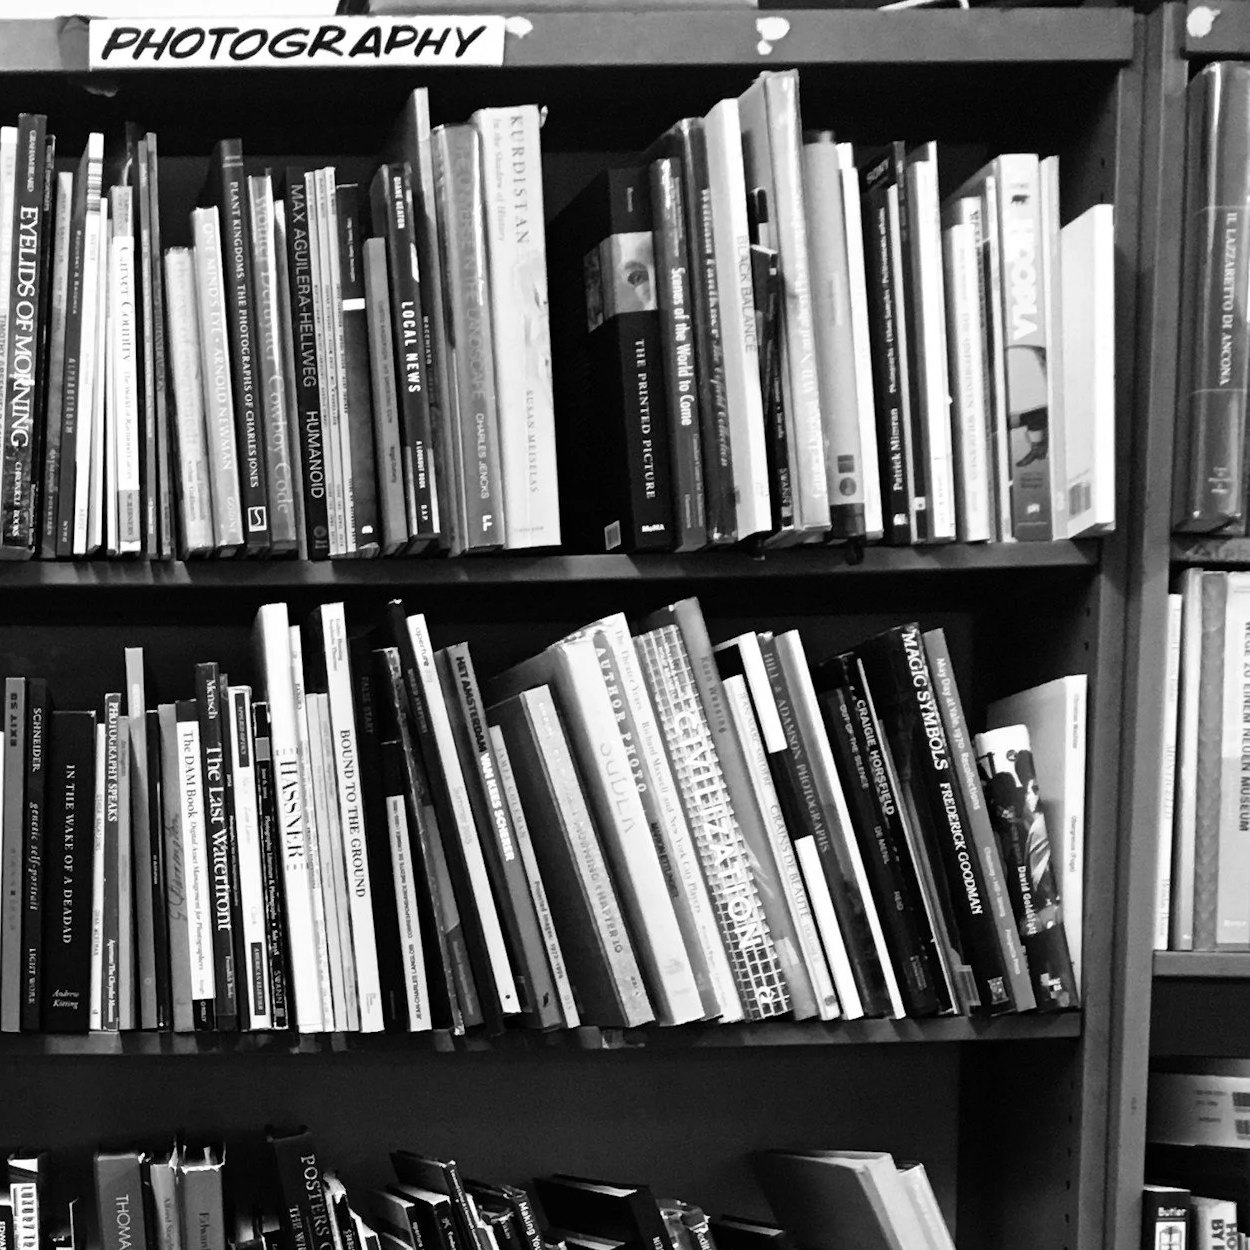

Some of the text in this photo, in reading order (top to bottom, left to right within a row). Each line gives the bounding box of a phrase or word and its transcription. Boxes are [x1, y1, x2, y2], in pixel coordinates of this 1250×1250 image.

[101, 25, 487, 61] PHOTOGRAPHY
[510, 115, 530, 245] KURDISTAN
[10, 205, 39, 448] EYELIDS OF MORNING
[290, 184, 324, 499] MAX AGUILERA-HELLWEG HUMANOID
[402, 301, 421, 393] LOCAL NEWS
[671, 267, 695, 426] Scenes of the World to Come
[1218, 213, 1238, 385] IL LAZZARETTO DI ANCONA
[634, 339, 656, 499] THE PRINTED PICTURE
[62, 765, 75, 944] IN THE WAKE OF A DEADAD
[206, 746, 233, 930] The Last Waterfront
[901, 631, 983, 915] MAGIC SYMBOLS FREDERICK GOODMAN
